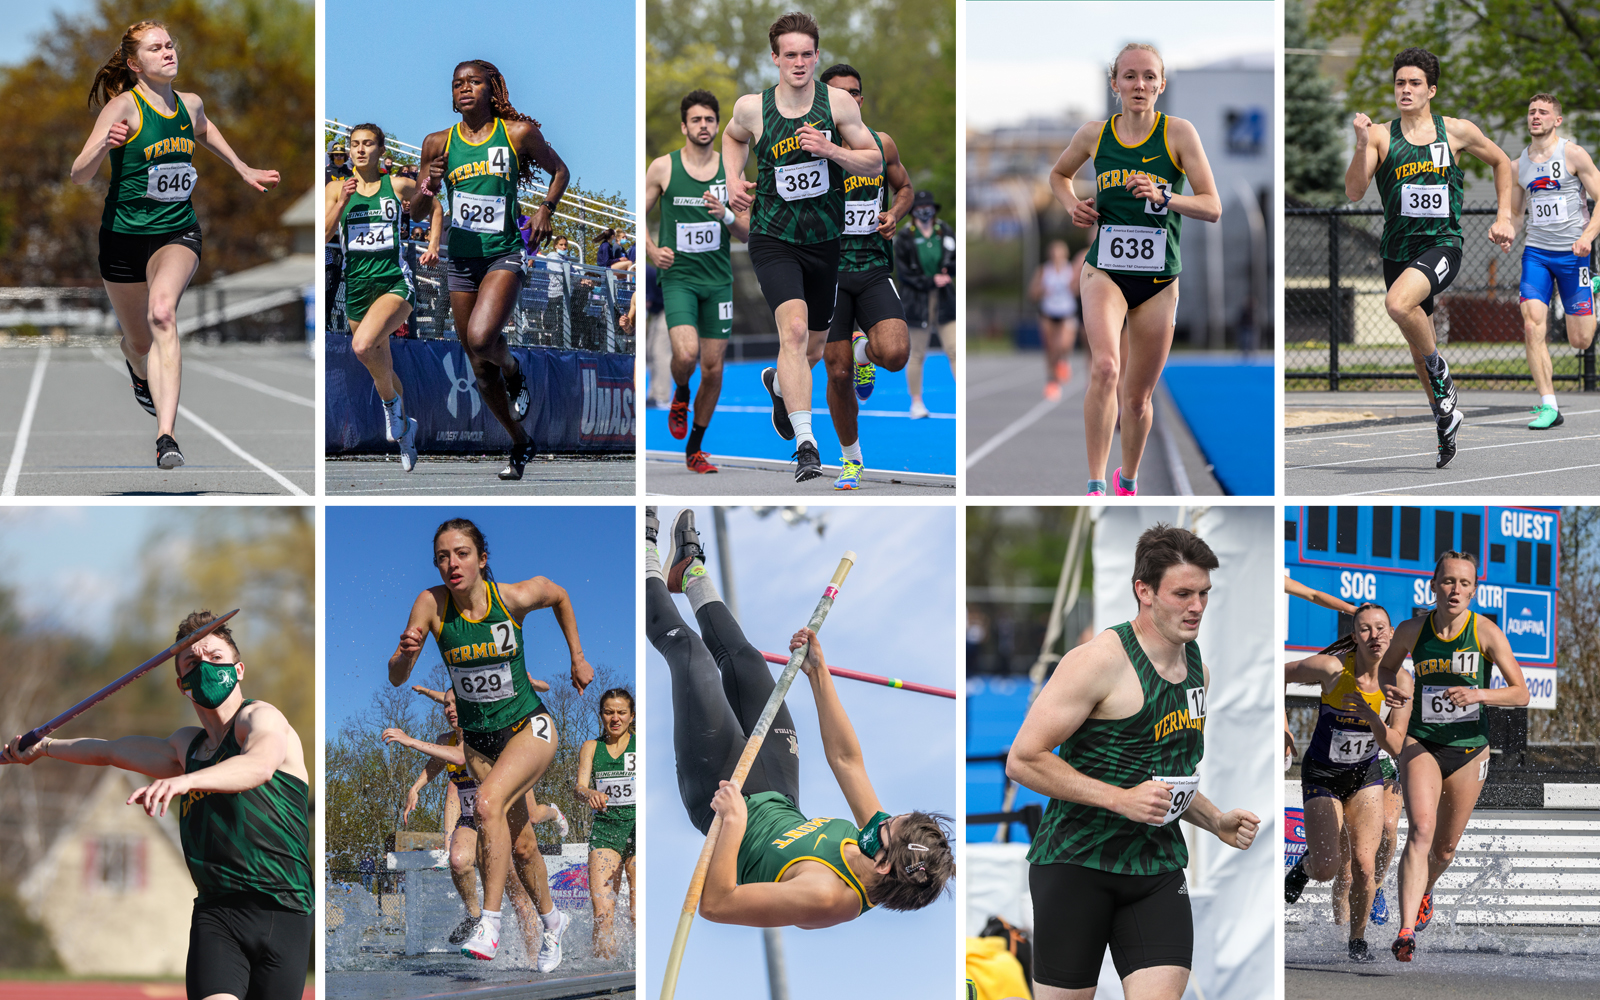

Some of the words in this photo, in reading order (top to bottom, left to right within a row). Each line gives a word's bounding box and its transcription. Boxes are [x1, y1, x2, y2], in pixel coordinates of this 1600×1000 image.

[144, 137, 196, 161] VERMON
[1434, 144, 1444, 165] 7
[492, 148, 506, 171] 4
[1552, 161, 1561, 178] 8
[157, 172, 191, 193] 646
[785, 171, 821, 192] 382
[385, 200, 394, 219] 6
[1409, 193, 1442, 209] 389
[1536, 203, 1559, 217] 301
[460, 203, 495, 223] 628
[845, 210, 875, 226] 372
[356, 231, 385, 246] 434
[685, 230, 713, 245] 150
[1110, 237, 1154, 260] 638
[1582, 268, 1588, 285] 8
[1500, 510, 1553, 541] GUEST
[1340, 571, 1376, 600] SOG
[1413, 578, 1436, 605] SO
[1477, 583, 1503, 608] QTR
[1507, 617, 1546, 637] AQUAFINA
[497, 624, 513, 652] 2
[1458, 653, 1474, 672] 11
[461, 674, 501, 693] 629
[1528, 678, 1552, 698] 2010
[1191, 688, 1205, 717] 12
[1431, 696, 1467, 714] 63
[536, 717, 548, 740] 2
[1340, 740, 1375, 755] 415
[628, 753, 636, 771] 3
[605, 784, 632, 798] 435
